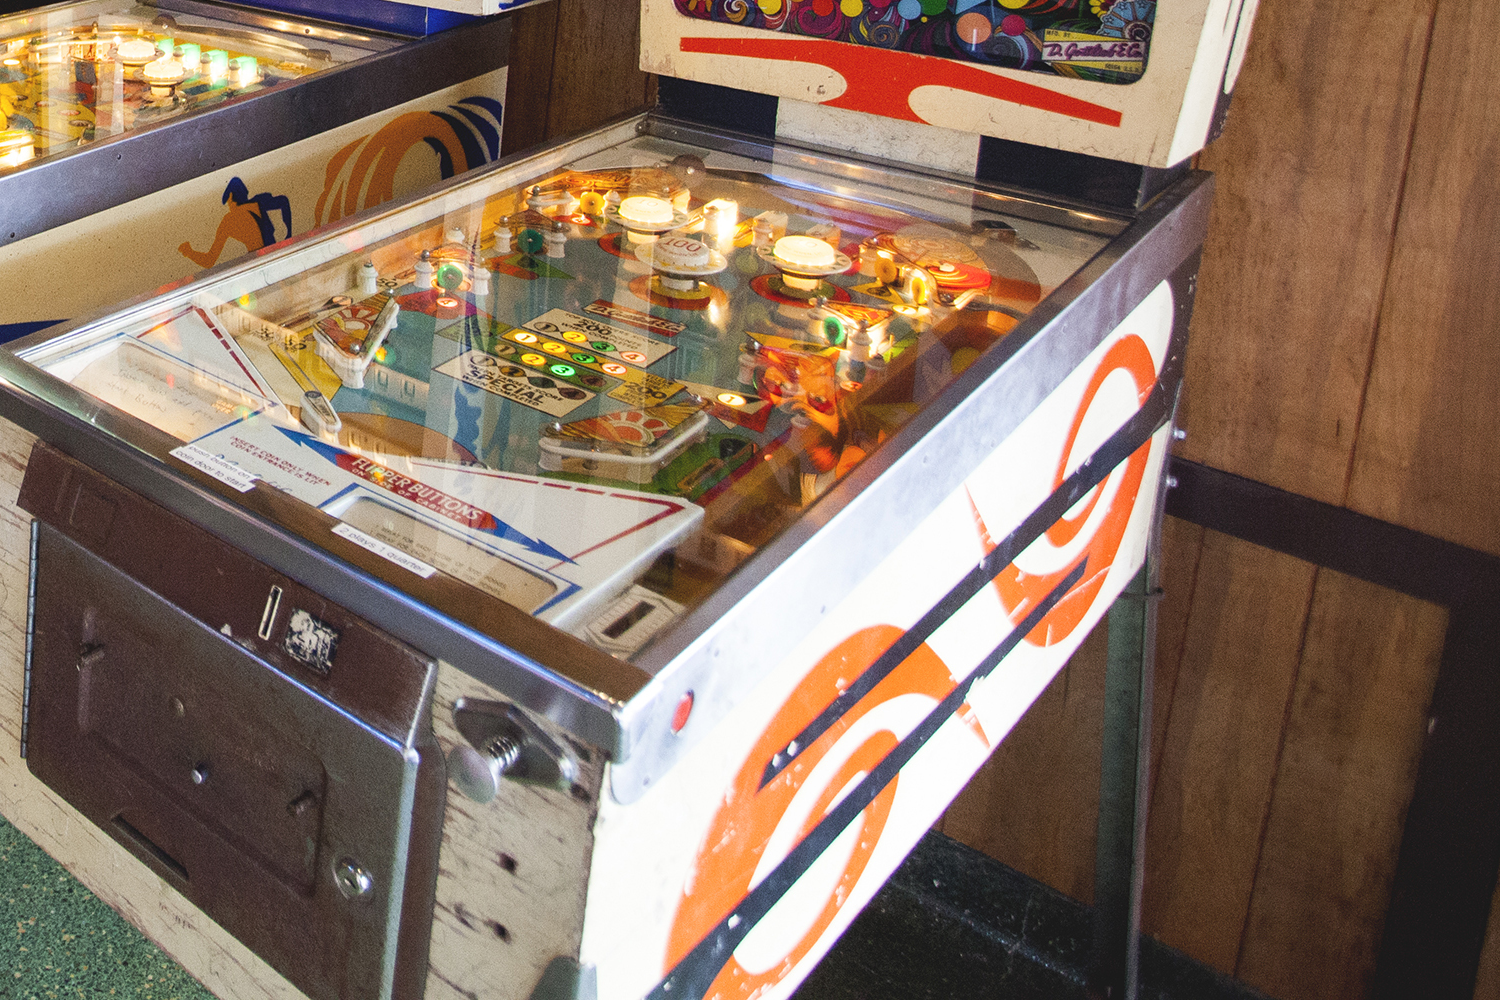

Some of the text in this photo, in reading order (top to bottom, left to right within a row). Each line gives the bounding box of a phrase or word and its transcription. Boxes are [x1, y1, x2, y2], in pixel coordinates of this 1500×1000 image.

[664, 238, 702, 253] 100
[573, 321, 612, 336] 200
[469, 369, 544, 405] SPECIAL
[175, 450, 247, 490] coin door to start
[188, 445, 251, 480] push button on
[229, 441, 323, 486] COIN ENTRANCE IS LIT
[230, 435, 333, 487] INSERT COIN ONLY WHEN
[351, 458, 483, 520] FLIPPER BUTTONS
[351, 468, 367, 478] ON
[397, 489, 413, 498] OF
[415, 498, 462, 520] CABINET
[338, 526, 349, 535] 2
[348, 531, 376, 549] plays
[386, 550, 427, 574] quarter
